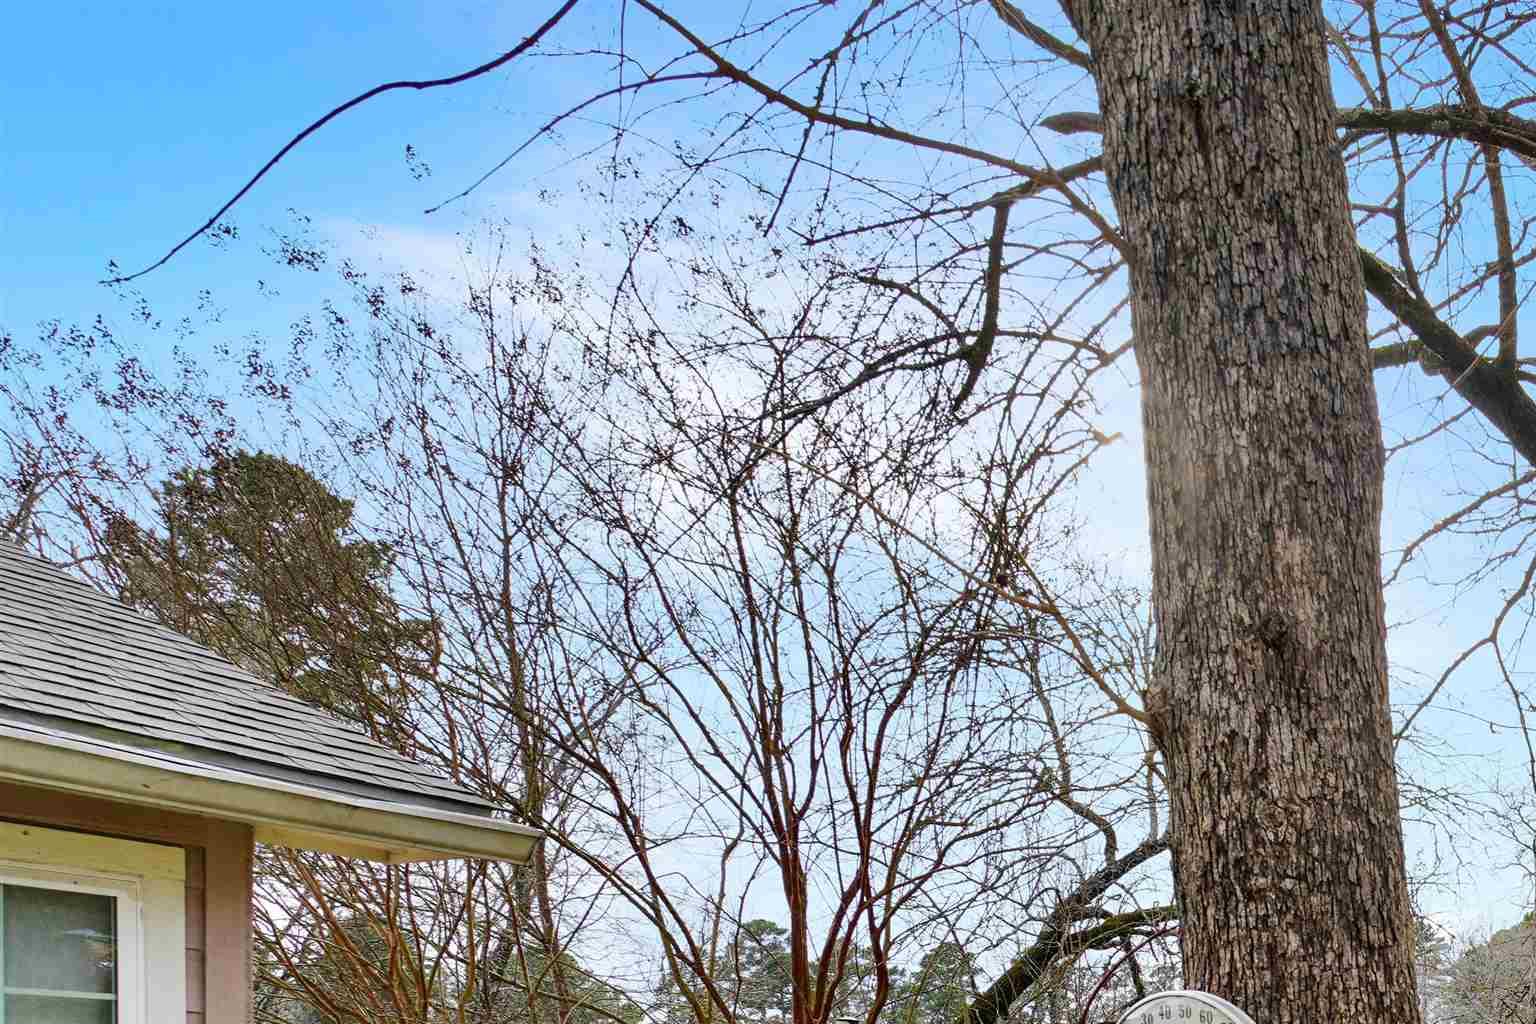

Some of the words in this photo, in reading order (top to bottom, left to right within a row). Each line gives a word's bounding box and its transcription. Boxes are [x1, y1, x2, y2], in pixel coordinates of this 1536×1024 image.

[1158, 1004, 1172, 1020] 40
[1178, 1004, 1192, 1019] 50
[1199, 1010, 1213, 1024] 60
